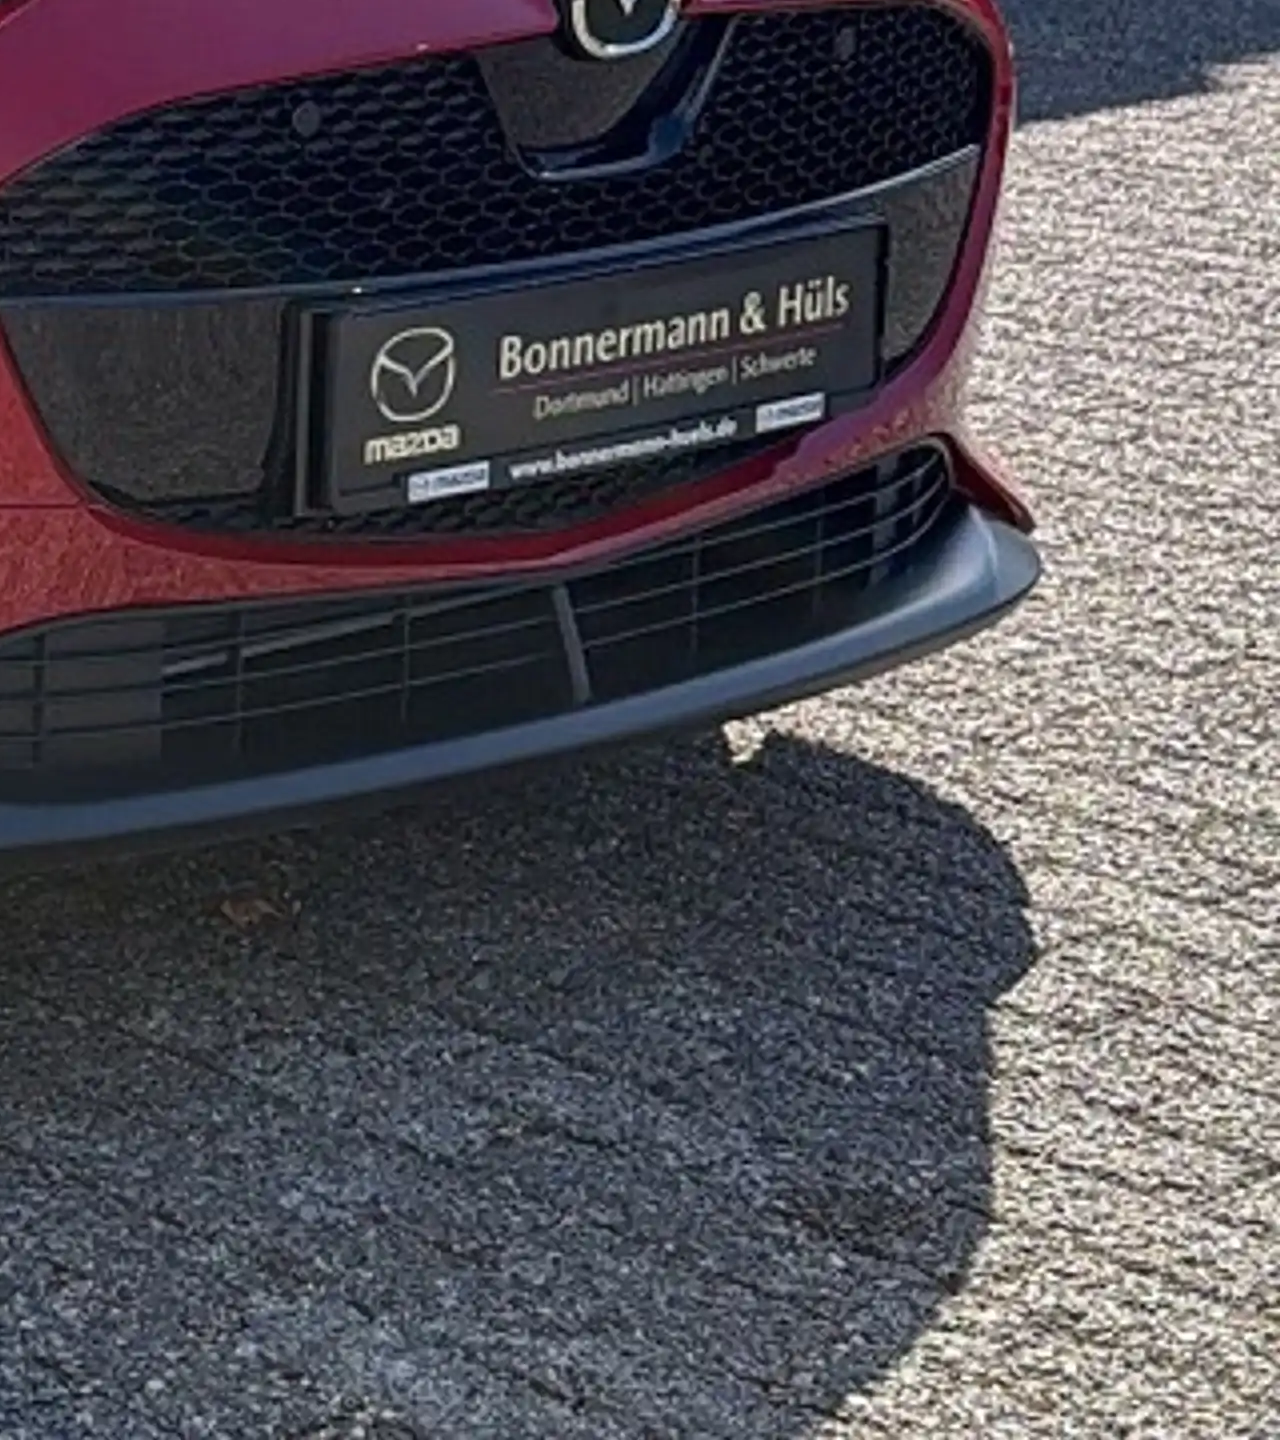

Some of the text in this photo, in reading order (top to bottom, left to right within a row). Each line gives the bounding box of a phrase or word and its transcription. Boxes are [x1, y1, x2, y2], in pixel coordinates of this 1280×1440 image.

[499, 275, 851, 380] Bonnermann & Hüls
[533, 346, 818, 420] Dortmund Hattingen Schwerte
[363, 423, 462, 465] mazda
